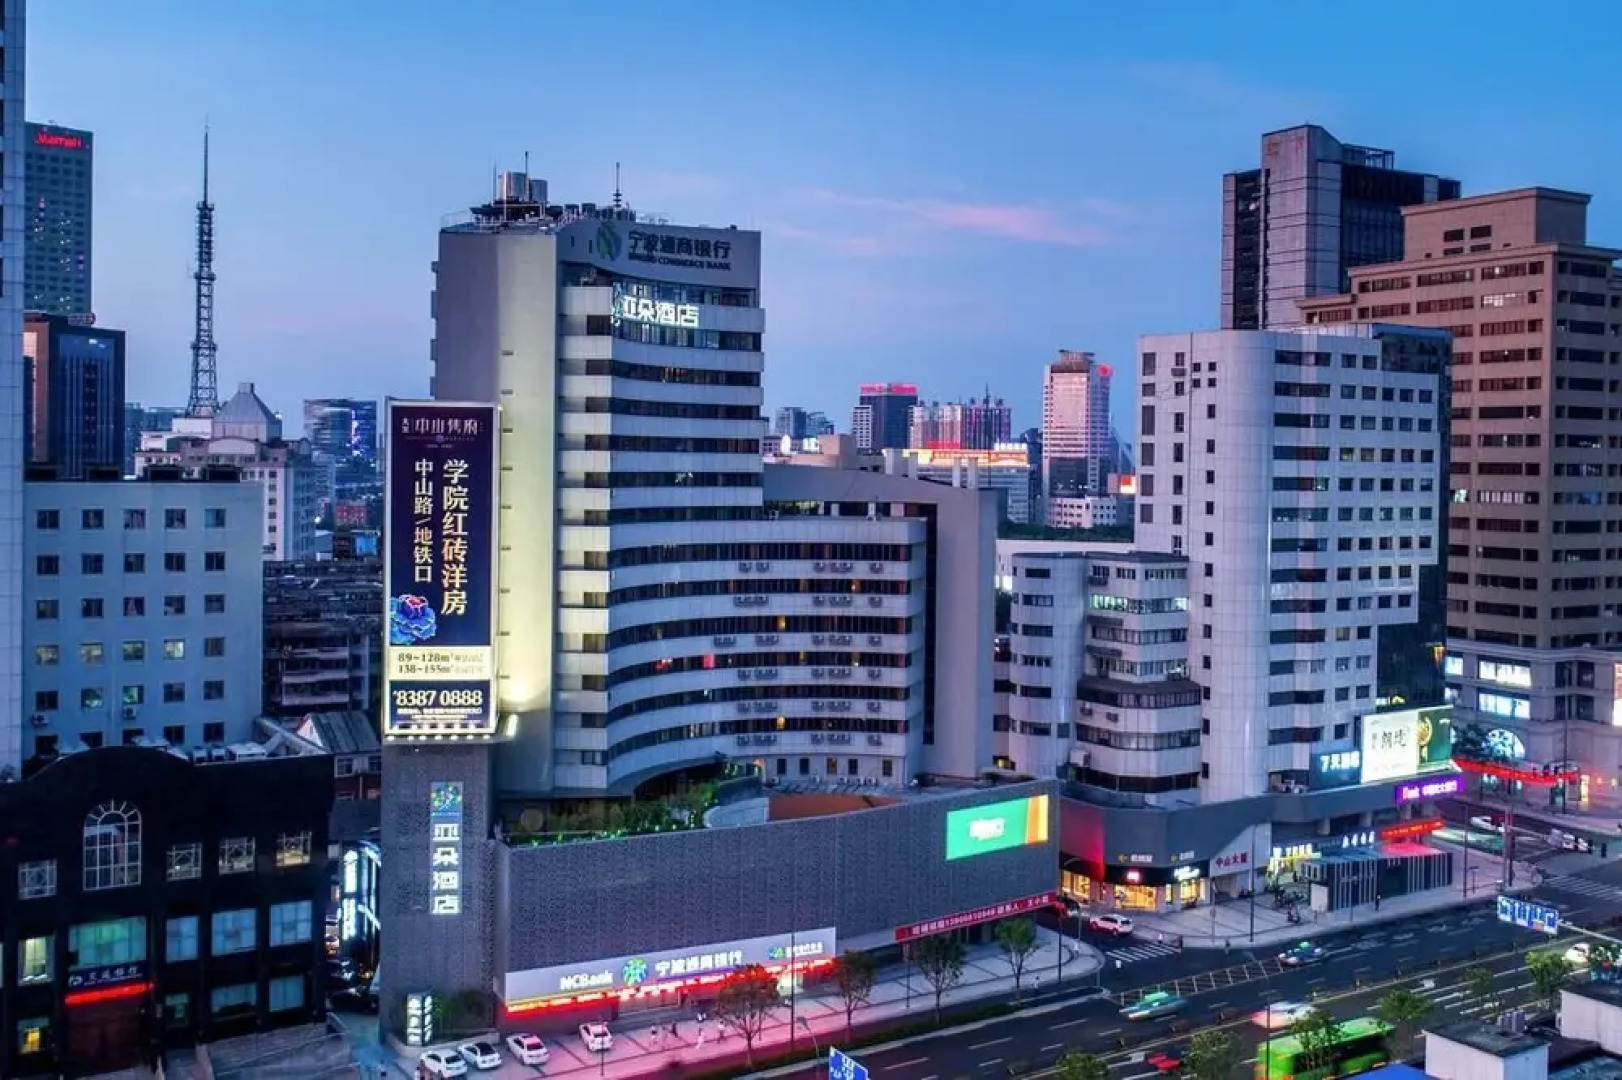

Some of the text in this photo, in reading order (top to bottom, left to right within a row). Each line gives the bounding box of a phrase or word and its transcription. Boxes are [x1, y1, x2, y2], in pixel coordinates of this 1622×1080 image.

[628, 230, 731, 259] 宁波通商银行
[623, 295, 700, 329] 亚朵酒店
[442, 458, 470, 616] 学院红砖洋房
[432, 823, 460, 915] 亚朵酒店
[559, 970, 614, 991] NCBank
